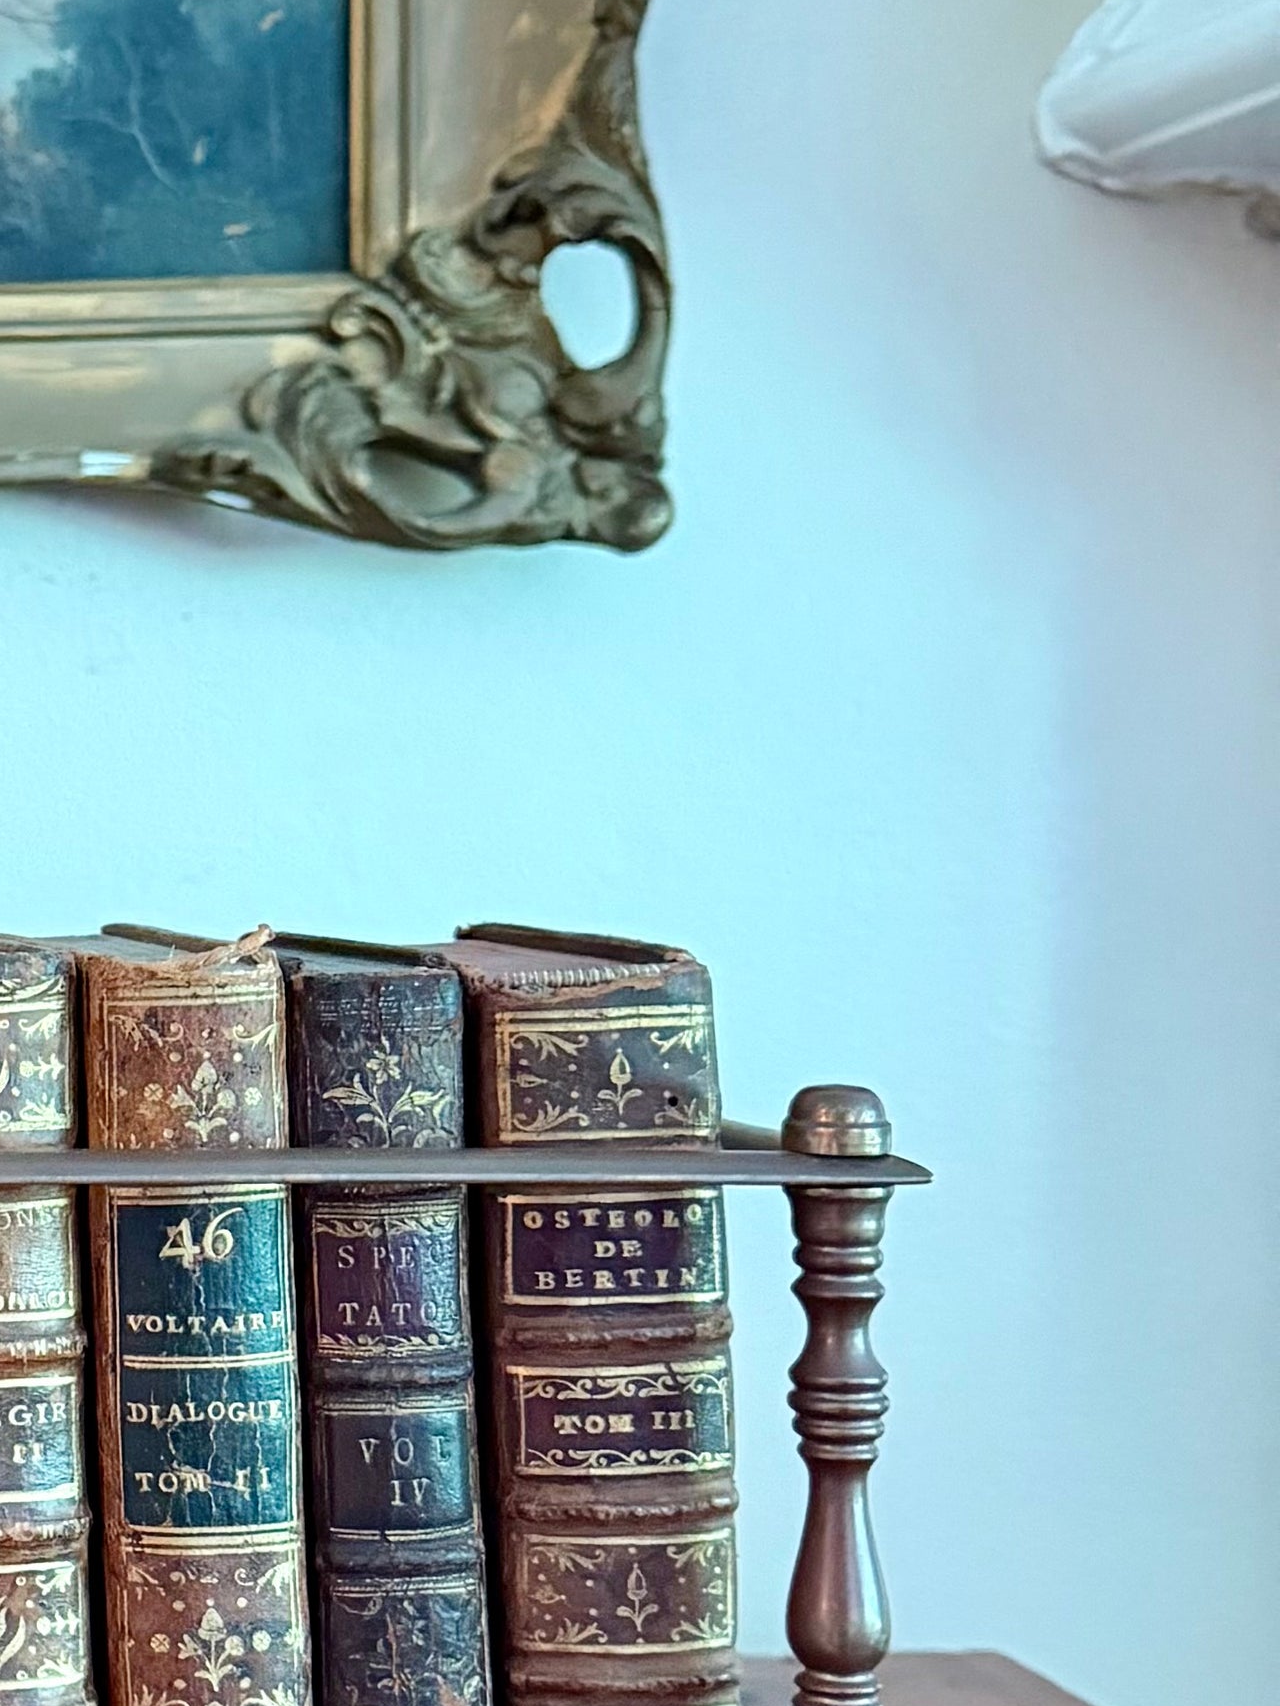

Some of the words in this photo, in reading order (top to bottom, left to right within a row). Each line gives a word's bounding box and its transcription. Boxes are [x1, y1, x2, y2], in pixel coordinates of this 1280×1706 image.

[158, 1207, 244, 1270] 46
[594, 1240, 643, 1258] DE
[535, 1267, 696, 1290] BERTIN
[126, 1311, 284, 1334] VOLTAIRE
[553, 1414, 636, 1435] TOM
[652, 1409, 696, 1431] III
[358, 1435, 451, 1465] VOL
[134, 1470, 212, 1493] TOM
[391, 1477, 432, 1507] IV
